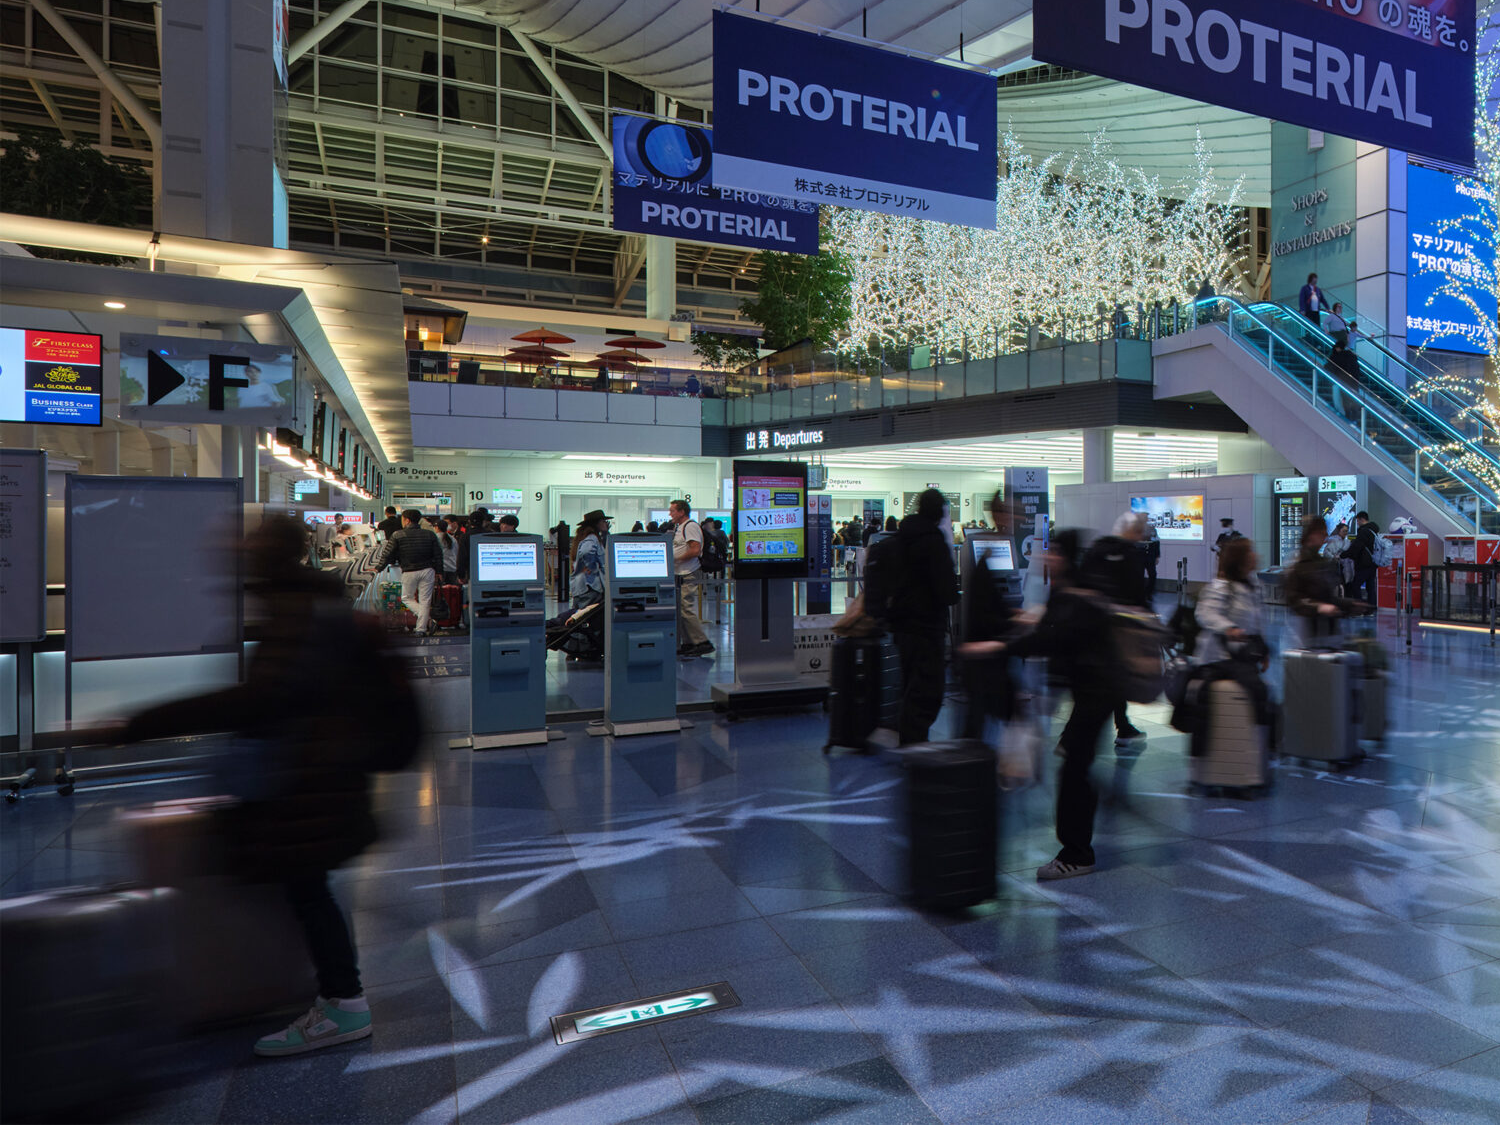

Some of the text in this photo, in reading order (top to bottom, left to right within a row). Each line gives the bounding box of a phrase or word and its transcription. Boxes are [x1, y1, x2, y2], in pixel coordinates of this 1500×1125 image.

[738, 68, 979, 151] PROTERIAL
[794, 177, 930, 211] 株式会社プロテリアル
[1291, 188, 1328, 213] SHOPS
[641, 200, 796, 243] PROTERIAL
[1304, 212, 1315, 226] &
[1272, 220, 1351, 258] RESTAURANTS
[1412, 233, 1474, 256] マテリアルに
[208, 354, 250, 411] F
[31, 398, 75, 407] BUSINESS
[746, 431, 769, 450] 出発
[773, 430, 824, 449] Departures
[411, 468, 458, 477] Departures
[606, 472, 646, 481] Departures
[469, 491, 484, 500] 10
[535, 491, 543, 502] 9
[685, 494, 692, 503] 8
[893, 497, 899, 506] 6
[964, 498, 970, 507] 5
